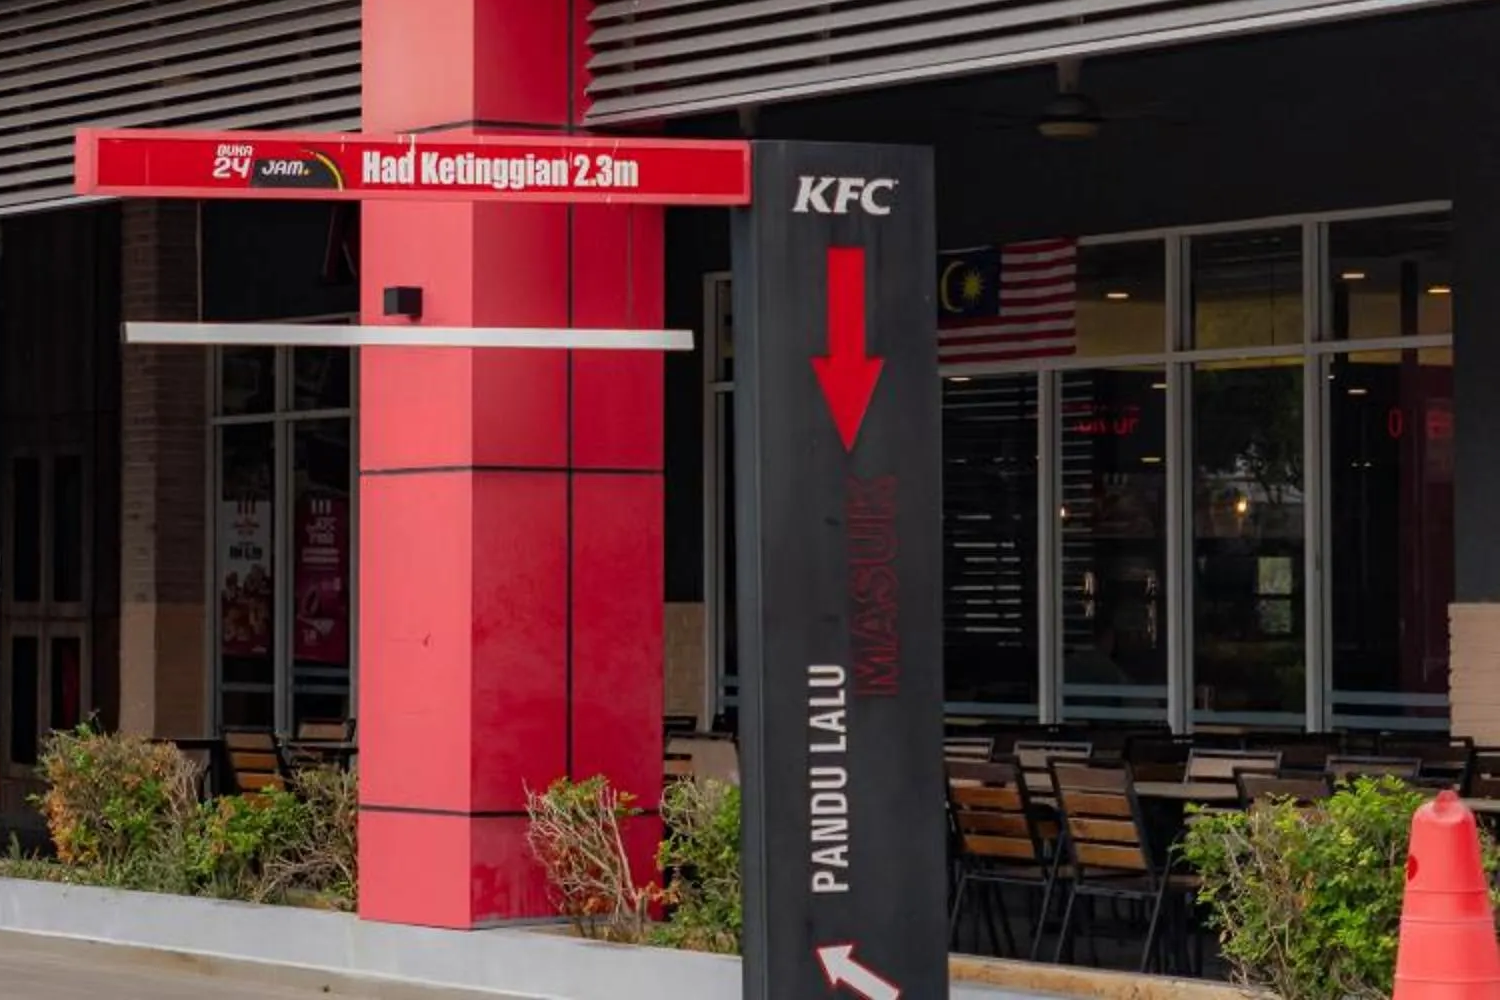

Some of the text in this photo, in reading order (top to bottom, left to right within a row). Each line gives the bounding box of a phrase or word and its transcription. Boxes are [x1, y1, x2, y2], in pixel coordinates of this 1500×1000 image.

[212, 158, 251, 179] 24
[362, 151, 639, 189] Had Ketinggian 2.3m
[792, 175, 894, 216] KFC
[807, 665, 850, 893] PANDU LALU
